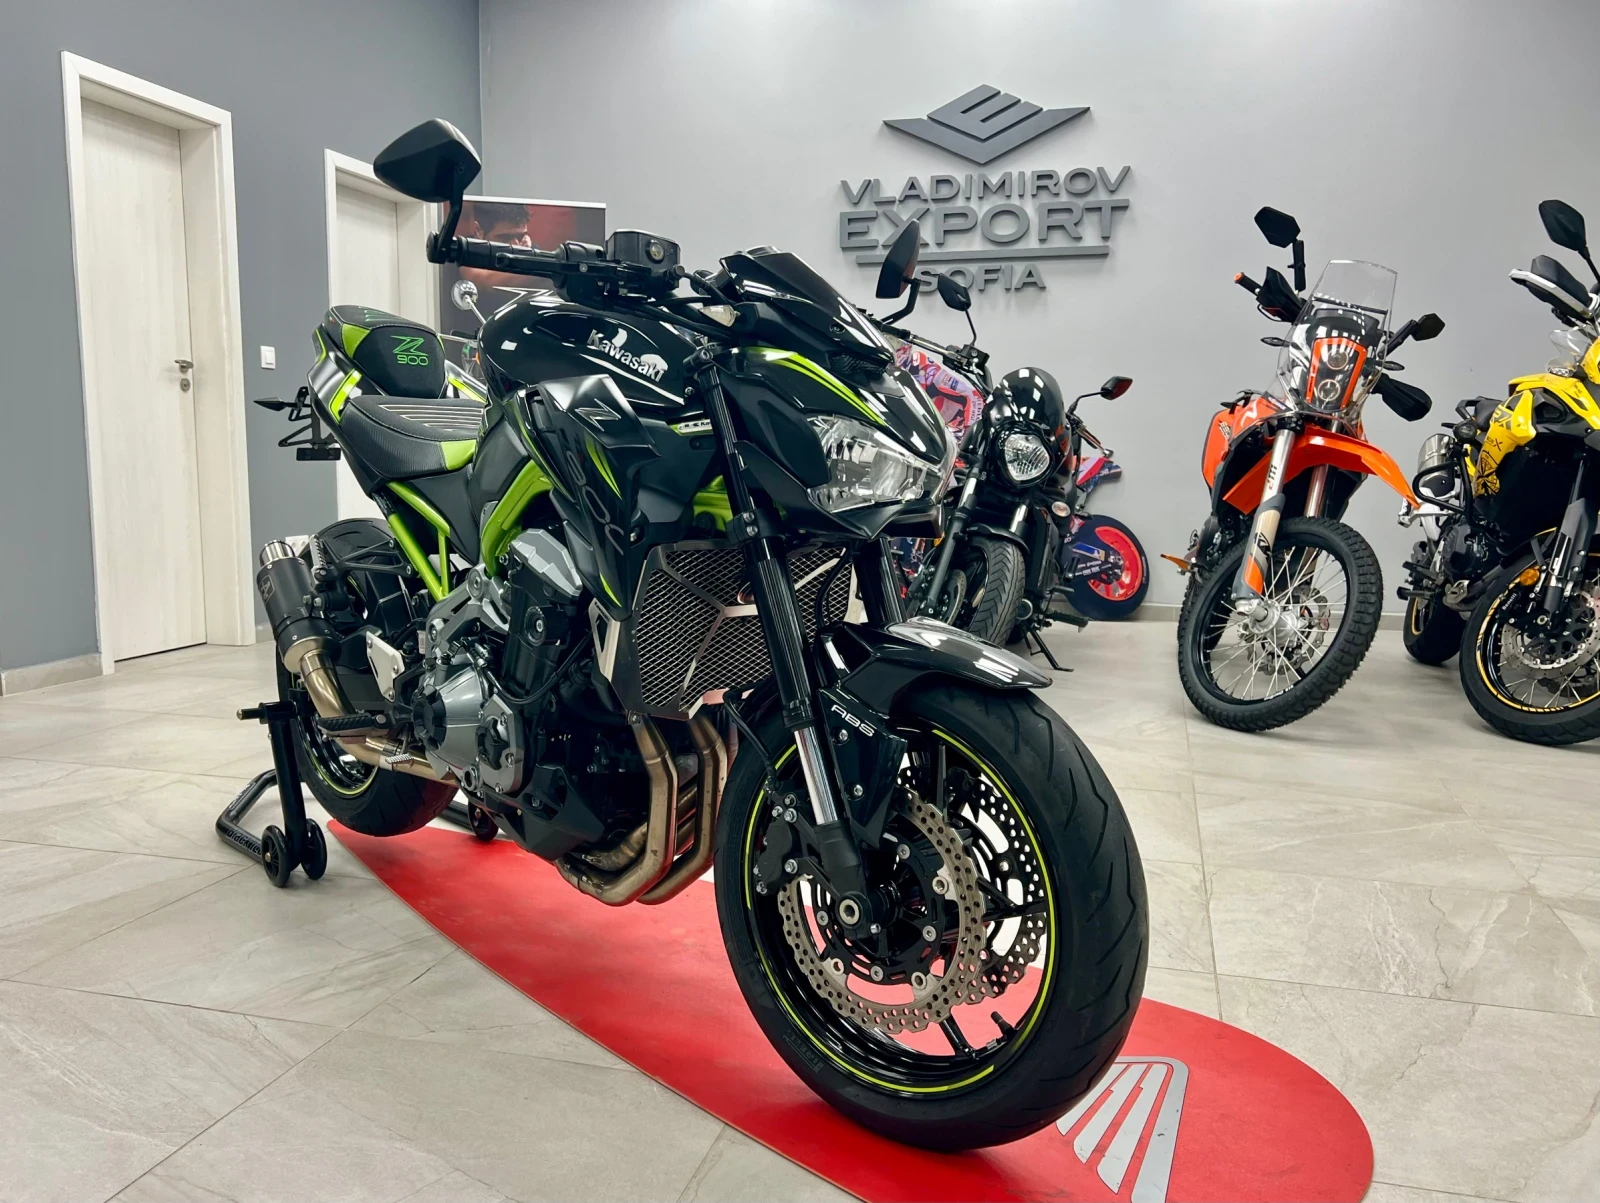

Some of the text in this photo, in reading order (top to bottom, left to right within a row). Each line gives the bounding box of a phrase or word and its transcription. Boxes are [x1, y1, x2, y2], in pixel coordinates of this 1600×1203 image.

[840, 165, 1131, 204] VLADIMIROV
[839, 199, 1130, 249] EXPORT
[917, 263, 1047, 293] SOFIA
[396, 354, 429, 366] 900
[586, 329, 665, 383] Kawasaki
[830, 704, 875, 737] ABS
